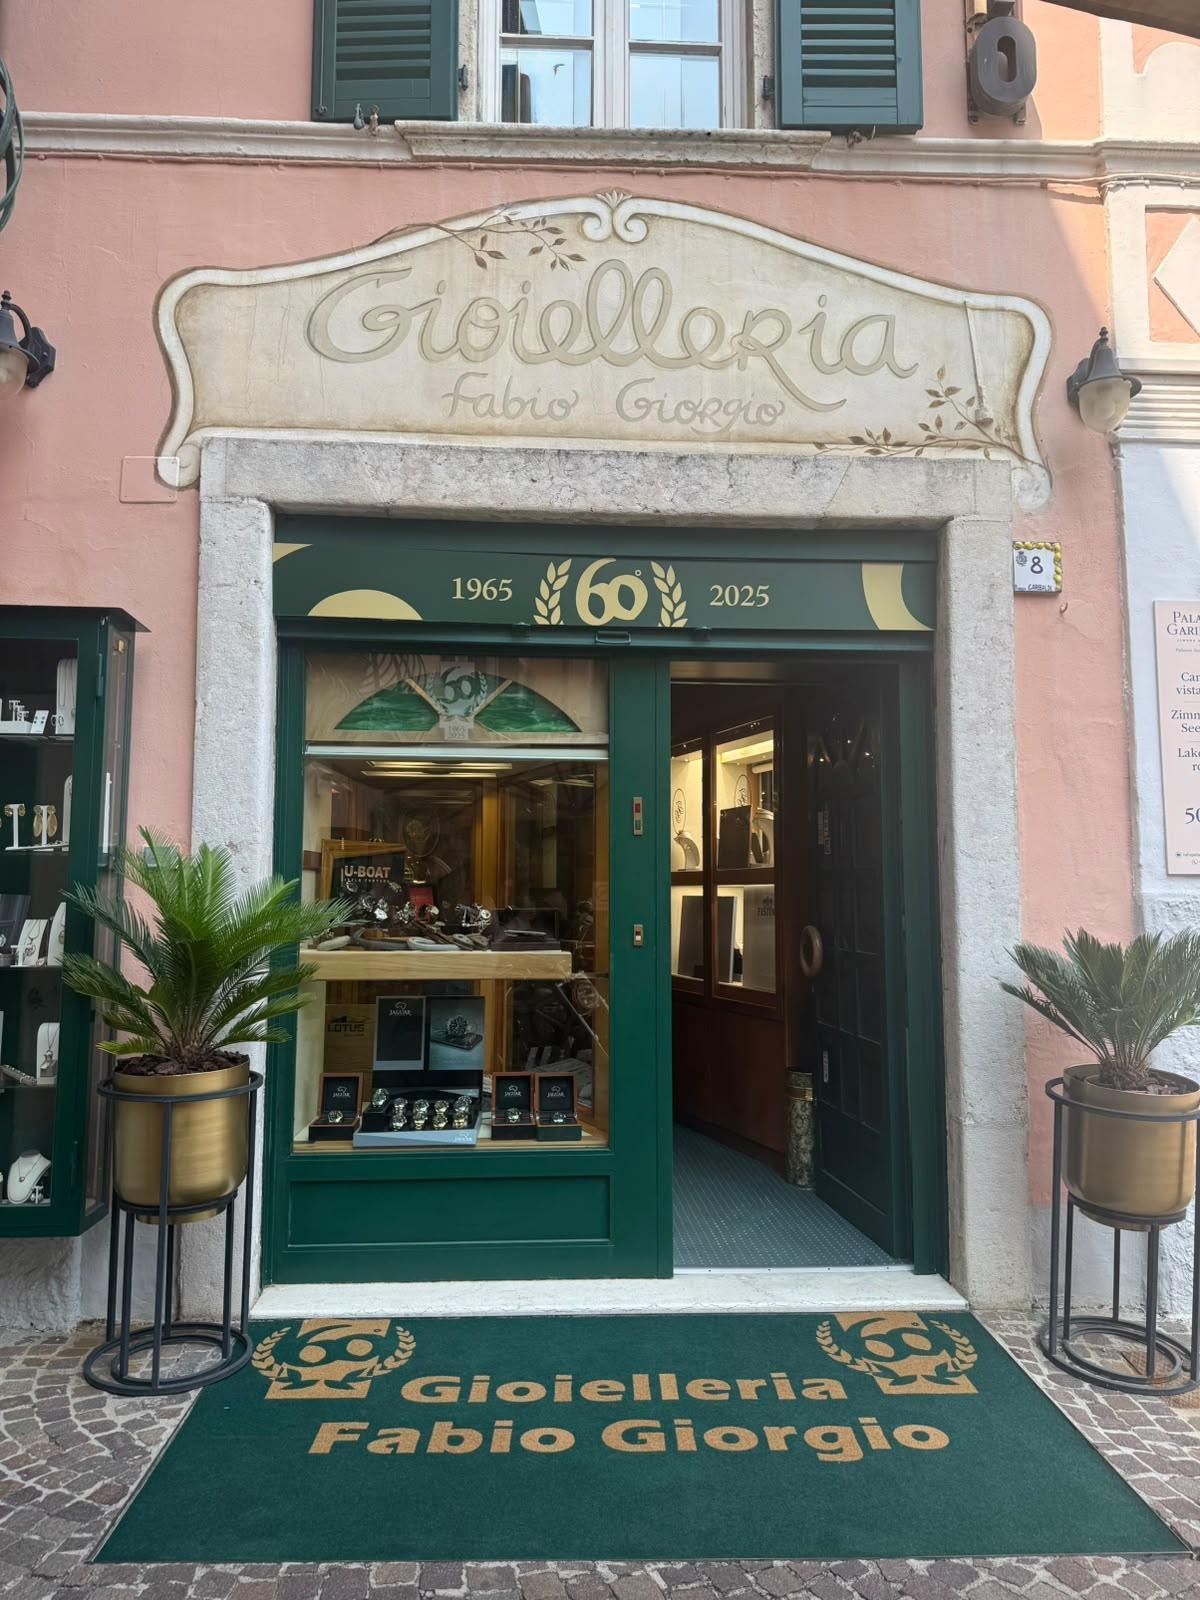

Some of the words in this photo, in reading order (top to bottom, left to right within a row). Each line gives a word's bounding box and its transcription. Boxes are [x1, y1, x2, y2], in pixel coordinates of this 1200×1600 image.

[441, 372, 579, 422] Fabio
[1030, 555, 1044, 575] 8
[451, 577, 513, 602] 1965
[709, 584, 770, 608] 2025
[1181, 723, 1200, 733] See
[344, 865, 391, 878] U-BOAT
[327, 1024, 365, 1032] LOTUS
[399, 1372, 849, 1403] Gioielleria
[308, 1420, 576, 1454] Fabio
[601, 1416, 950, 1463] Giorgio
